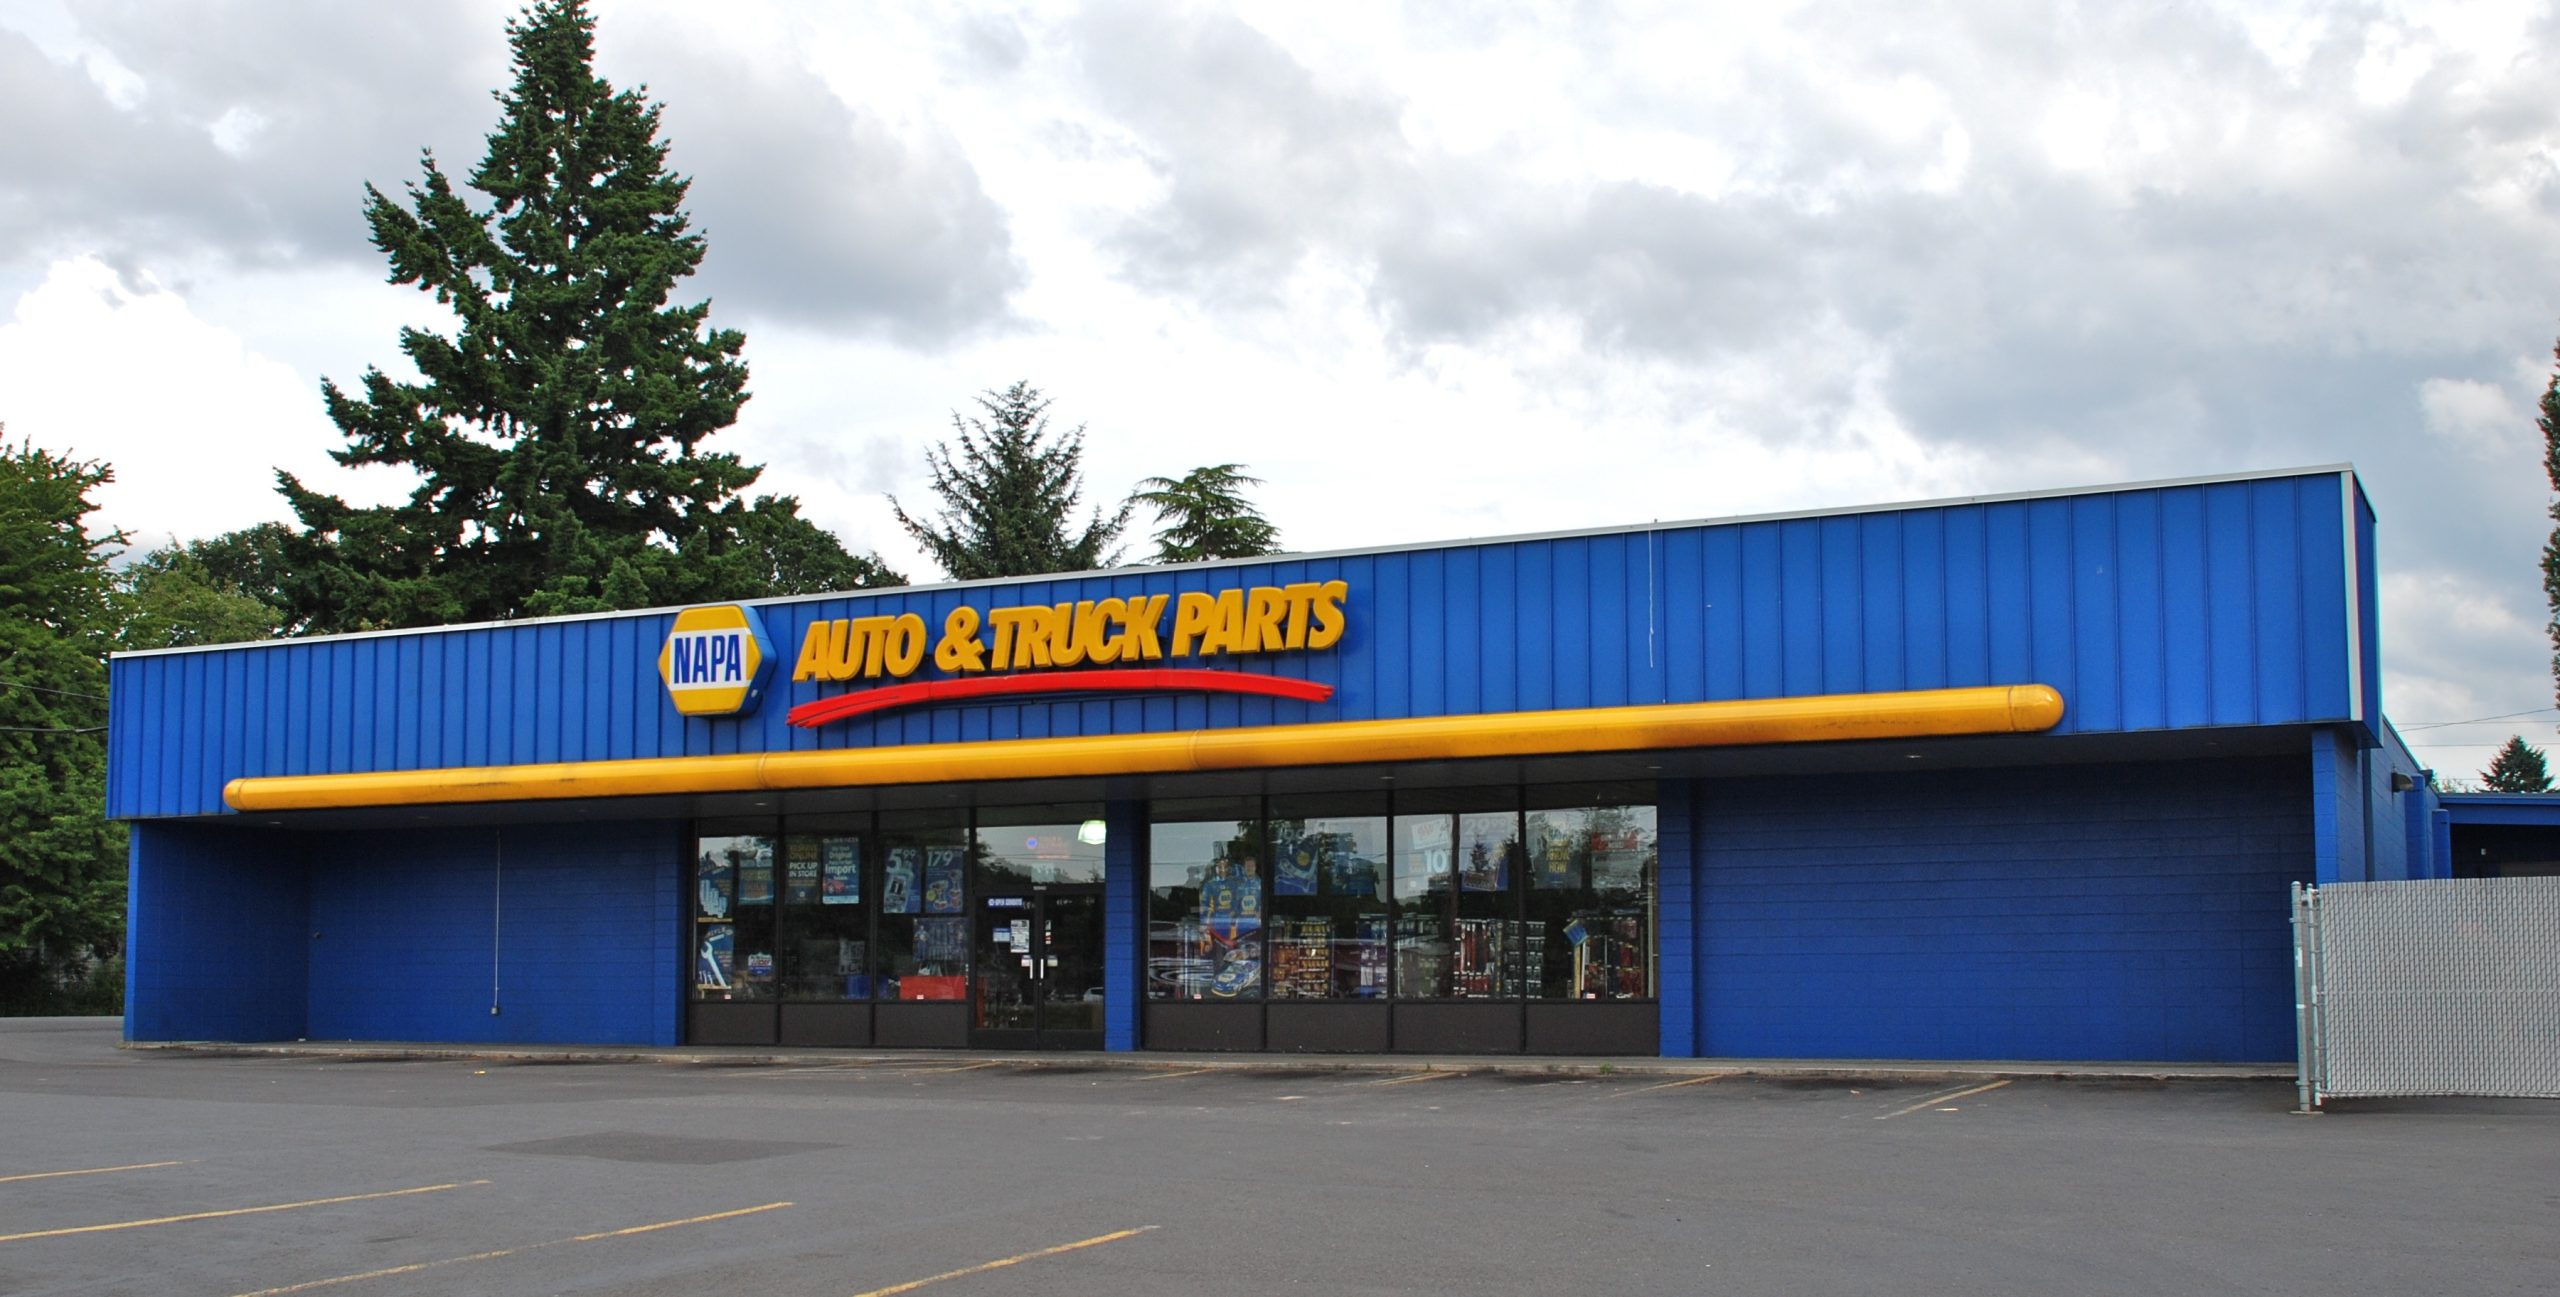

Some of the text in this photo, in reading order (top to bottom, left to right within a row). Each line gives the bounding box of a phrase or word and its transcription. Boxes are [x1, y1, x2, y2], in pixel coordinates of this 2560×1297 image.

[792, 580, 1348, 682] AUTO & TRUCK PARTS
[673, 633, 741, 685] NAPA
[789, 862, 818, 870] PICK UP
[825, 863, 857, 876] Import
